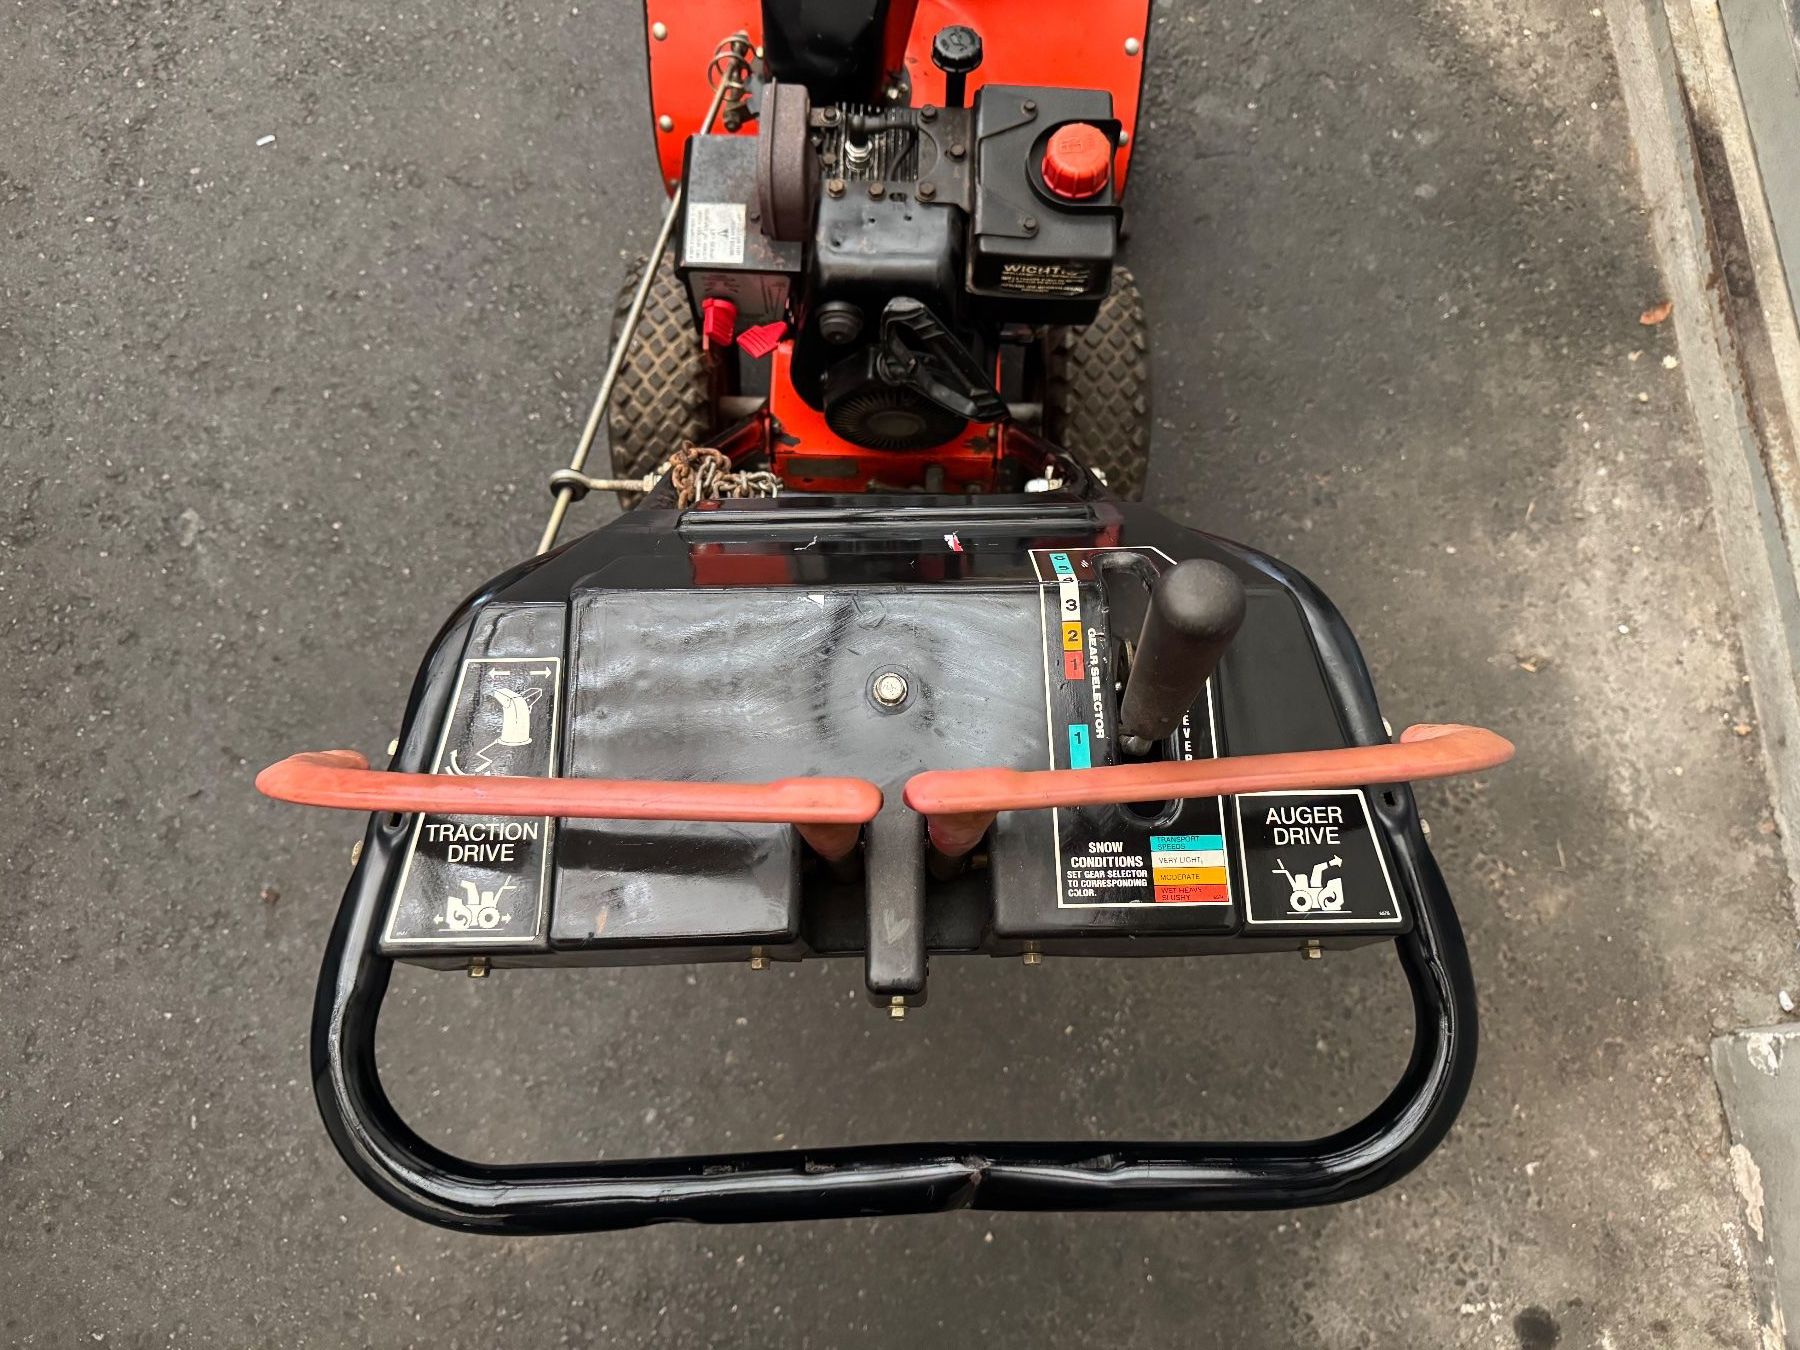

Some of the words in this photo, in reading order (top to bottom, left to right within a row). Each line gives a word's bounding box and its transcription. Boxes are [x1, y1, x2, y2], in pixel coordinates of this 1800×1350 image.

[1065, 599, 1078, 611] 3
[1067, 630, 1079, 642] 2
[1087, 627, 1099, 665] GEAR
[1069, 658, 1078, 671] 1
[1089, 666, 1105, 739] SELECTOR
[1073, 731, 1083, 745] 1
[1266, 806, 1344, 825] AUGER
[425, 822, 538, 842] TRACTION
[1273, 826, 1341, 846] DRIVE
[447, 843, 515, 863] DRIVE
[1088, 841, 1124, 854] SNOW
[1070, 855, 1144, 868] CONDITIONS
[1066, 870, 1082, 879] SET
[1084, 870, 1106, 879] GEAR
[1107, 869, 1148, 878] SELECTOR
[1160, 873, 1201, 881] MODERATE
[1067, 879, 1079, 888] TO
[1081, 878, 1148, 888] CORRESPONDING
[1067, 888, 1097, 897] COLOR.
